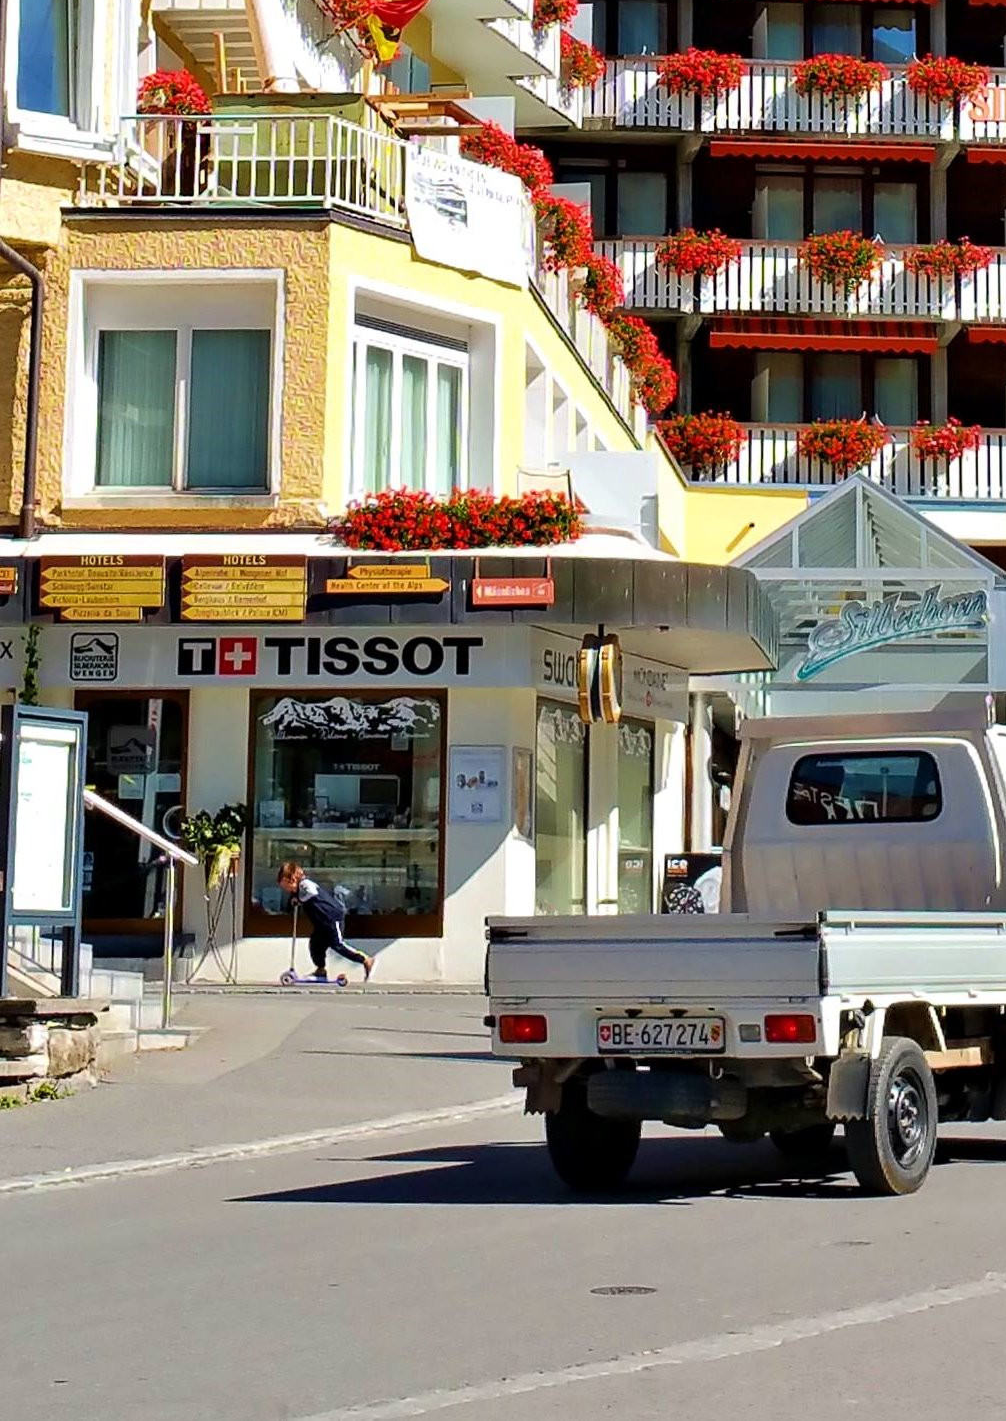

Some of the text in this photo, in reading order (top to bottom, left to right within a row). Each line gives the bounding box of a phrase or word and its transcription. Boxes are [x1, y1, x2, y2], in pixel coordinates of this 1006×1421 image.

[81, 555, 124, 566] HOTELS
[223, 555, 267, 565] HOTELS
[407, 582, 422, 591] Alps
[264, 637, 484, 676] TISSOT
